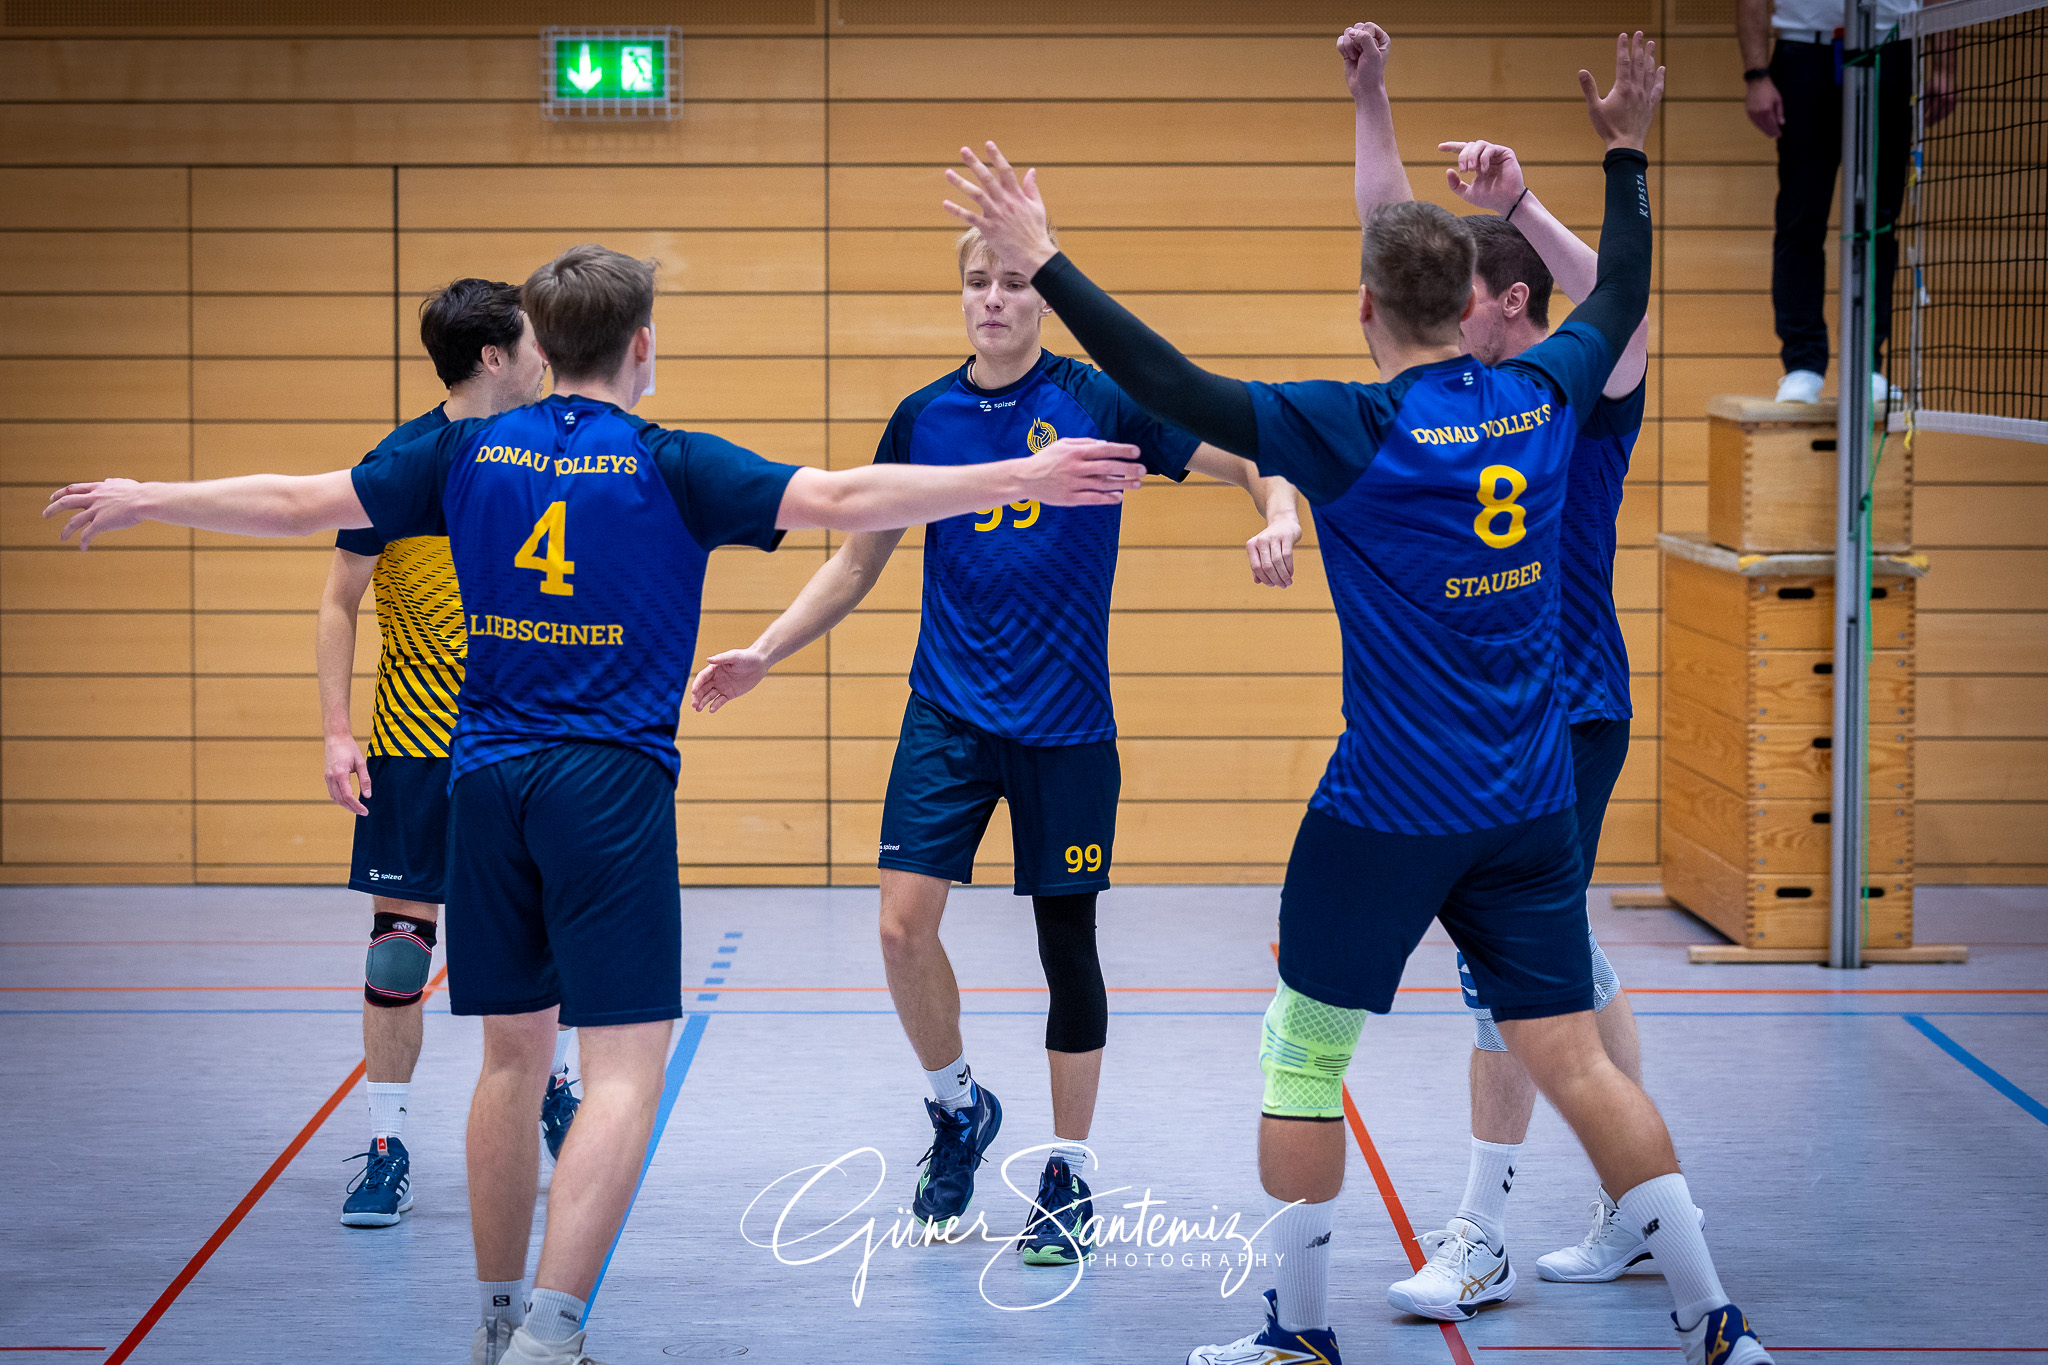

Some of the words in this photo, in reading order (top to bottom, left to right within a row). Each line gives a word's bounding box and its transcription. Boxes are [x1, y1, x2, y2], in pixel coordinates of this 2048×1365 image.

[1636, 174, 1648, 218] KIPSTA
[994, 400, 1016, 409] spized
[1411, 426, 1479, 445] DONAU
[1480, 404, 1551, 438] VOLLEYS
[475, 445, 550, 472] DONAU
[1474, 464, 1527, 549] 8
[514, 501, 575, 596] 4
[1445, 561, 1542, 598] STAUBER
[470, 614, 624, 645] LIEBSCHNER
[1064, 844, 1102, 873] 99
[381, 873, 403, 881] spized
